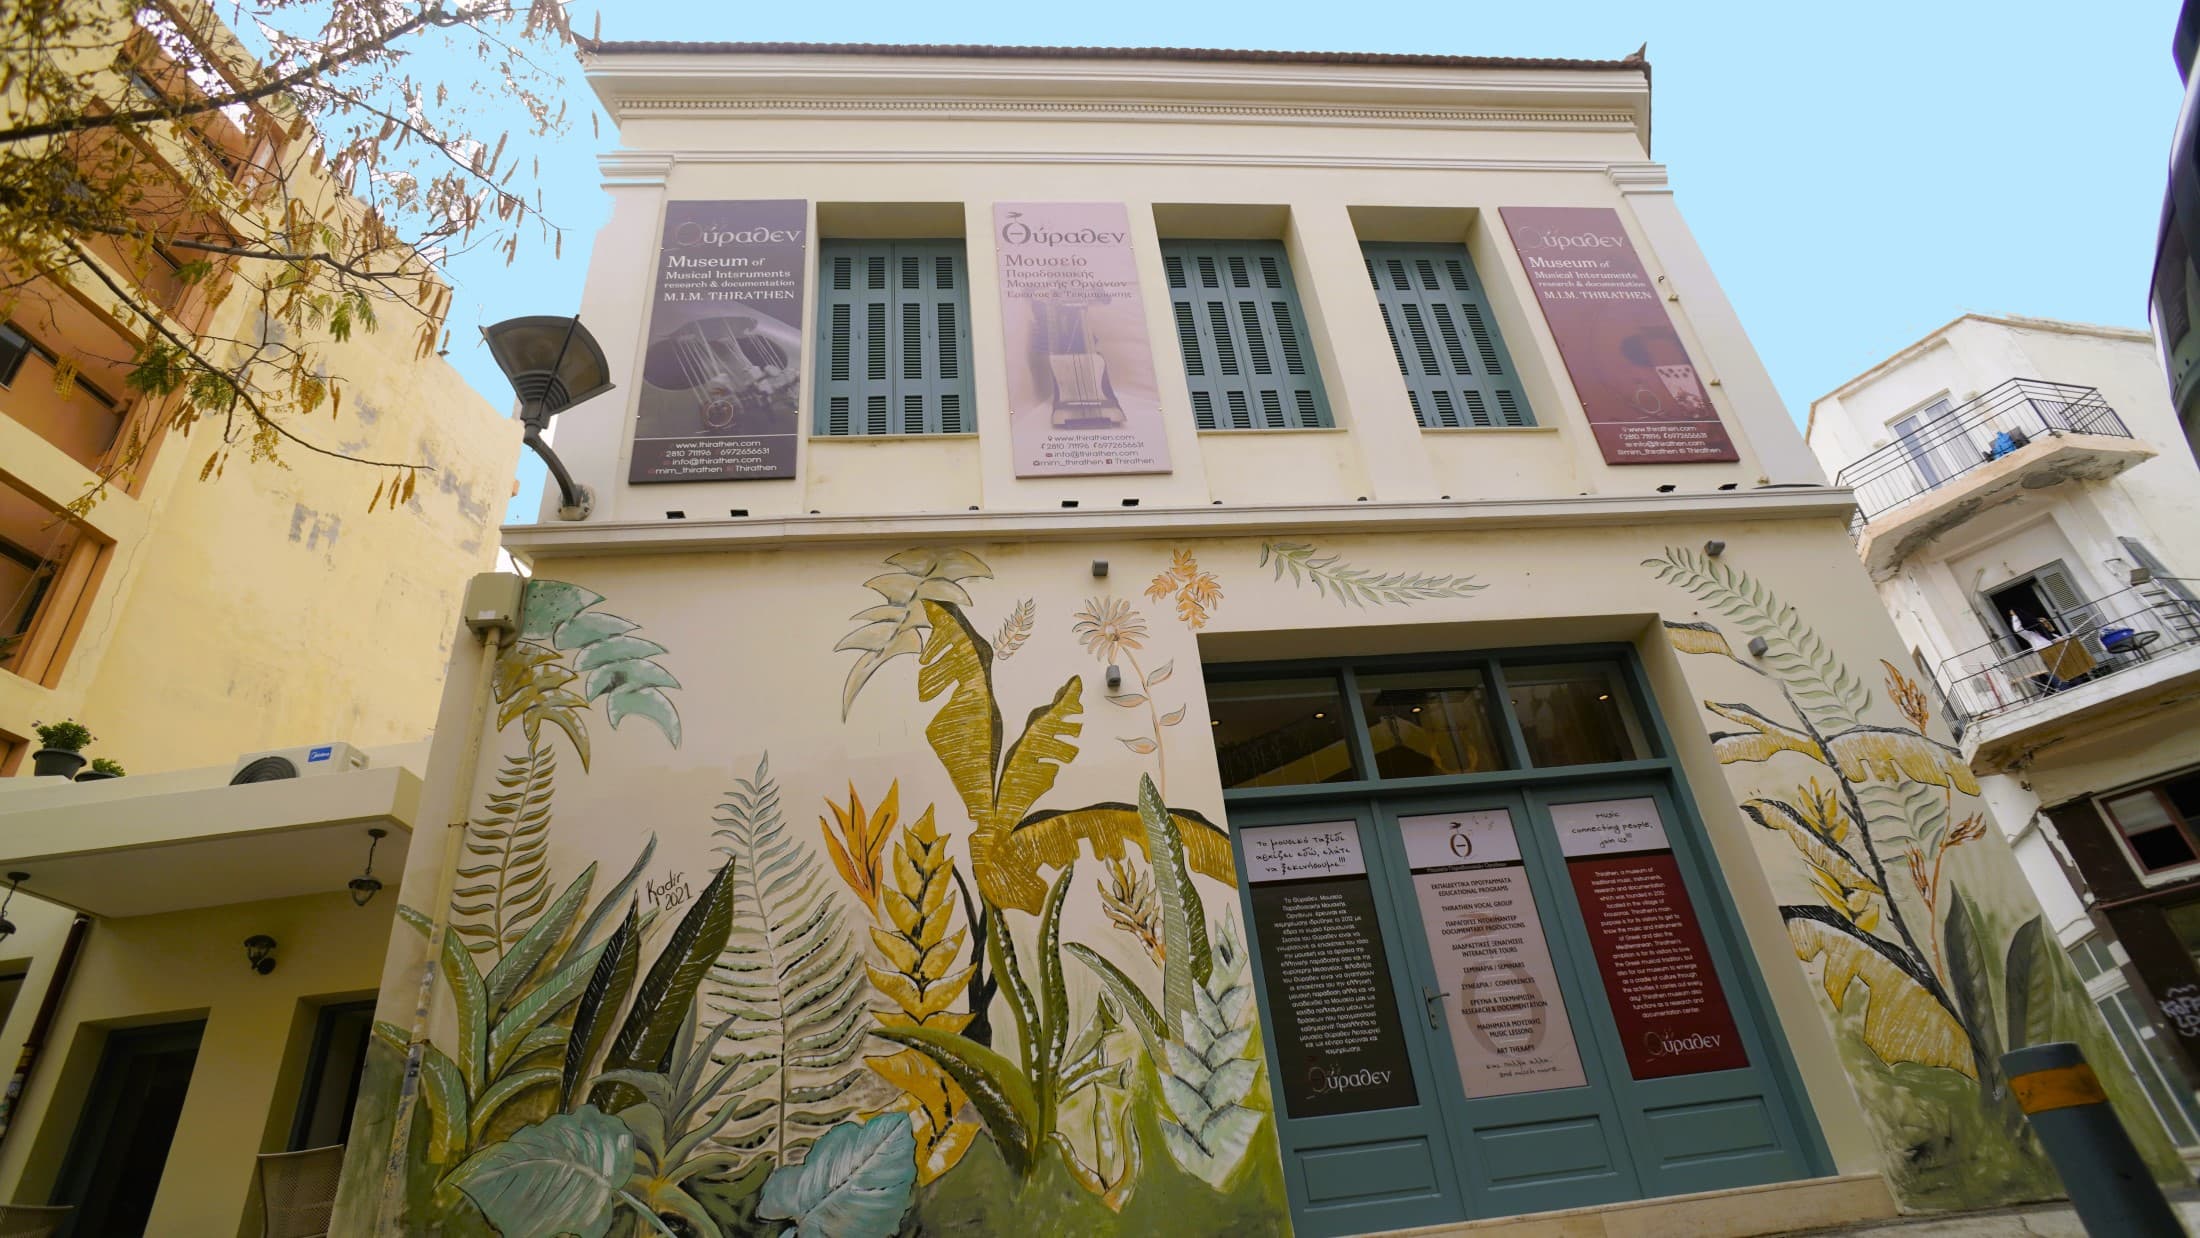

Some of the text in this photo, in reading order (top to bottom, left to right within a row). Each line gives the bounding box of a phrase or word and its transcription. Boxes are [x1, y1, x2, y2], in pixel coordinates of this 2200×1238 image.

[668, 256, 766, 268] Museum of
[1005, 254, 1088, 266] Μουσείο
[1528, 256, 1598, 268] Museum
[666, 271, 712, 279] Musical
[1534, 271, 1573, 280] Musical
[664, 291, 794, 301] M.I.M. THIRATHEN
[1580, 290, 1652, 299] THIRATHEN
[676, 440, 760, 449] www.thirathen.com
[672, 456, 761, 465] info@thirathen.com
[646, 868, 685, 907] Kadir
[1438, 888, 1478, 896] EDUCATIONAL
[666, 882, 694, 911] 2021
[1441, 922, 1526, 935] DOCUMENTARY PRODUCTIONS
[1461, 948, 1497, 957] INTERACTIVE
